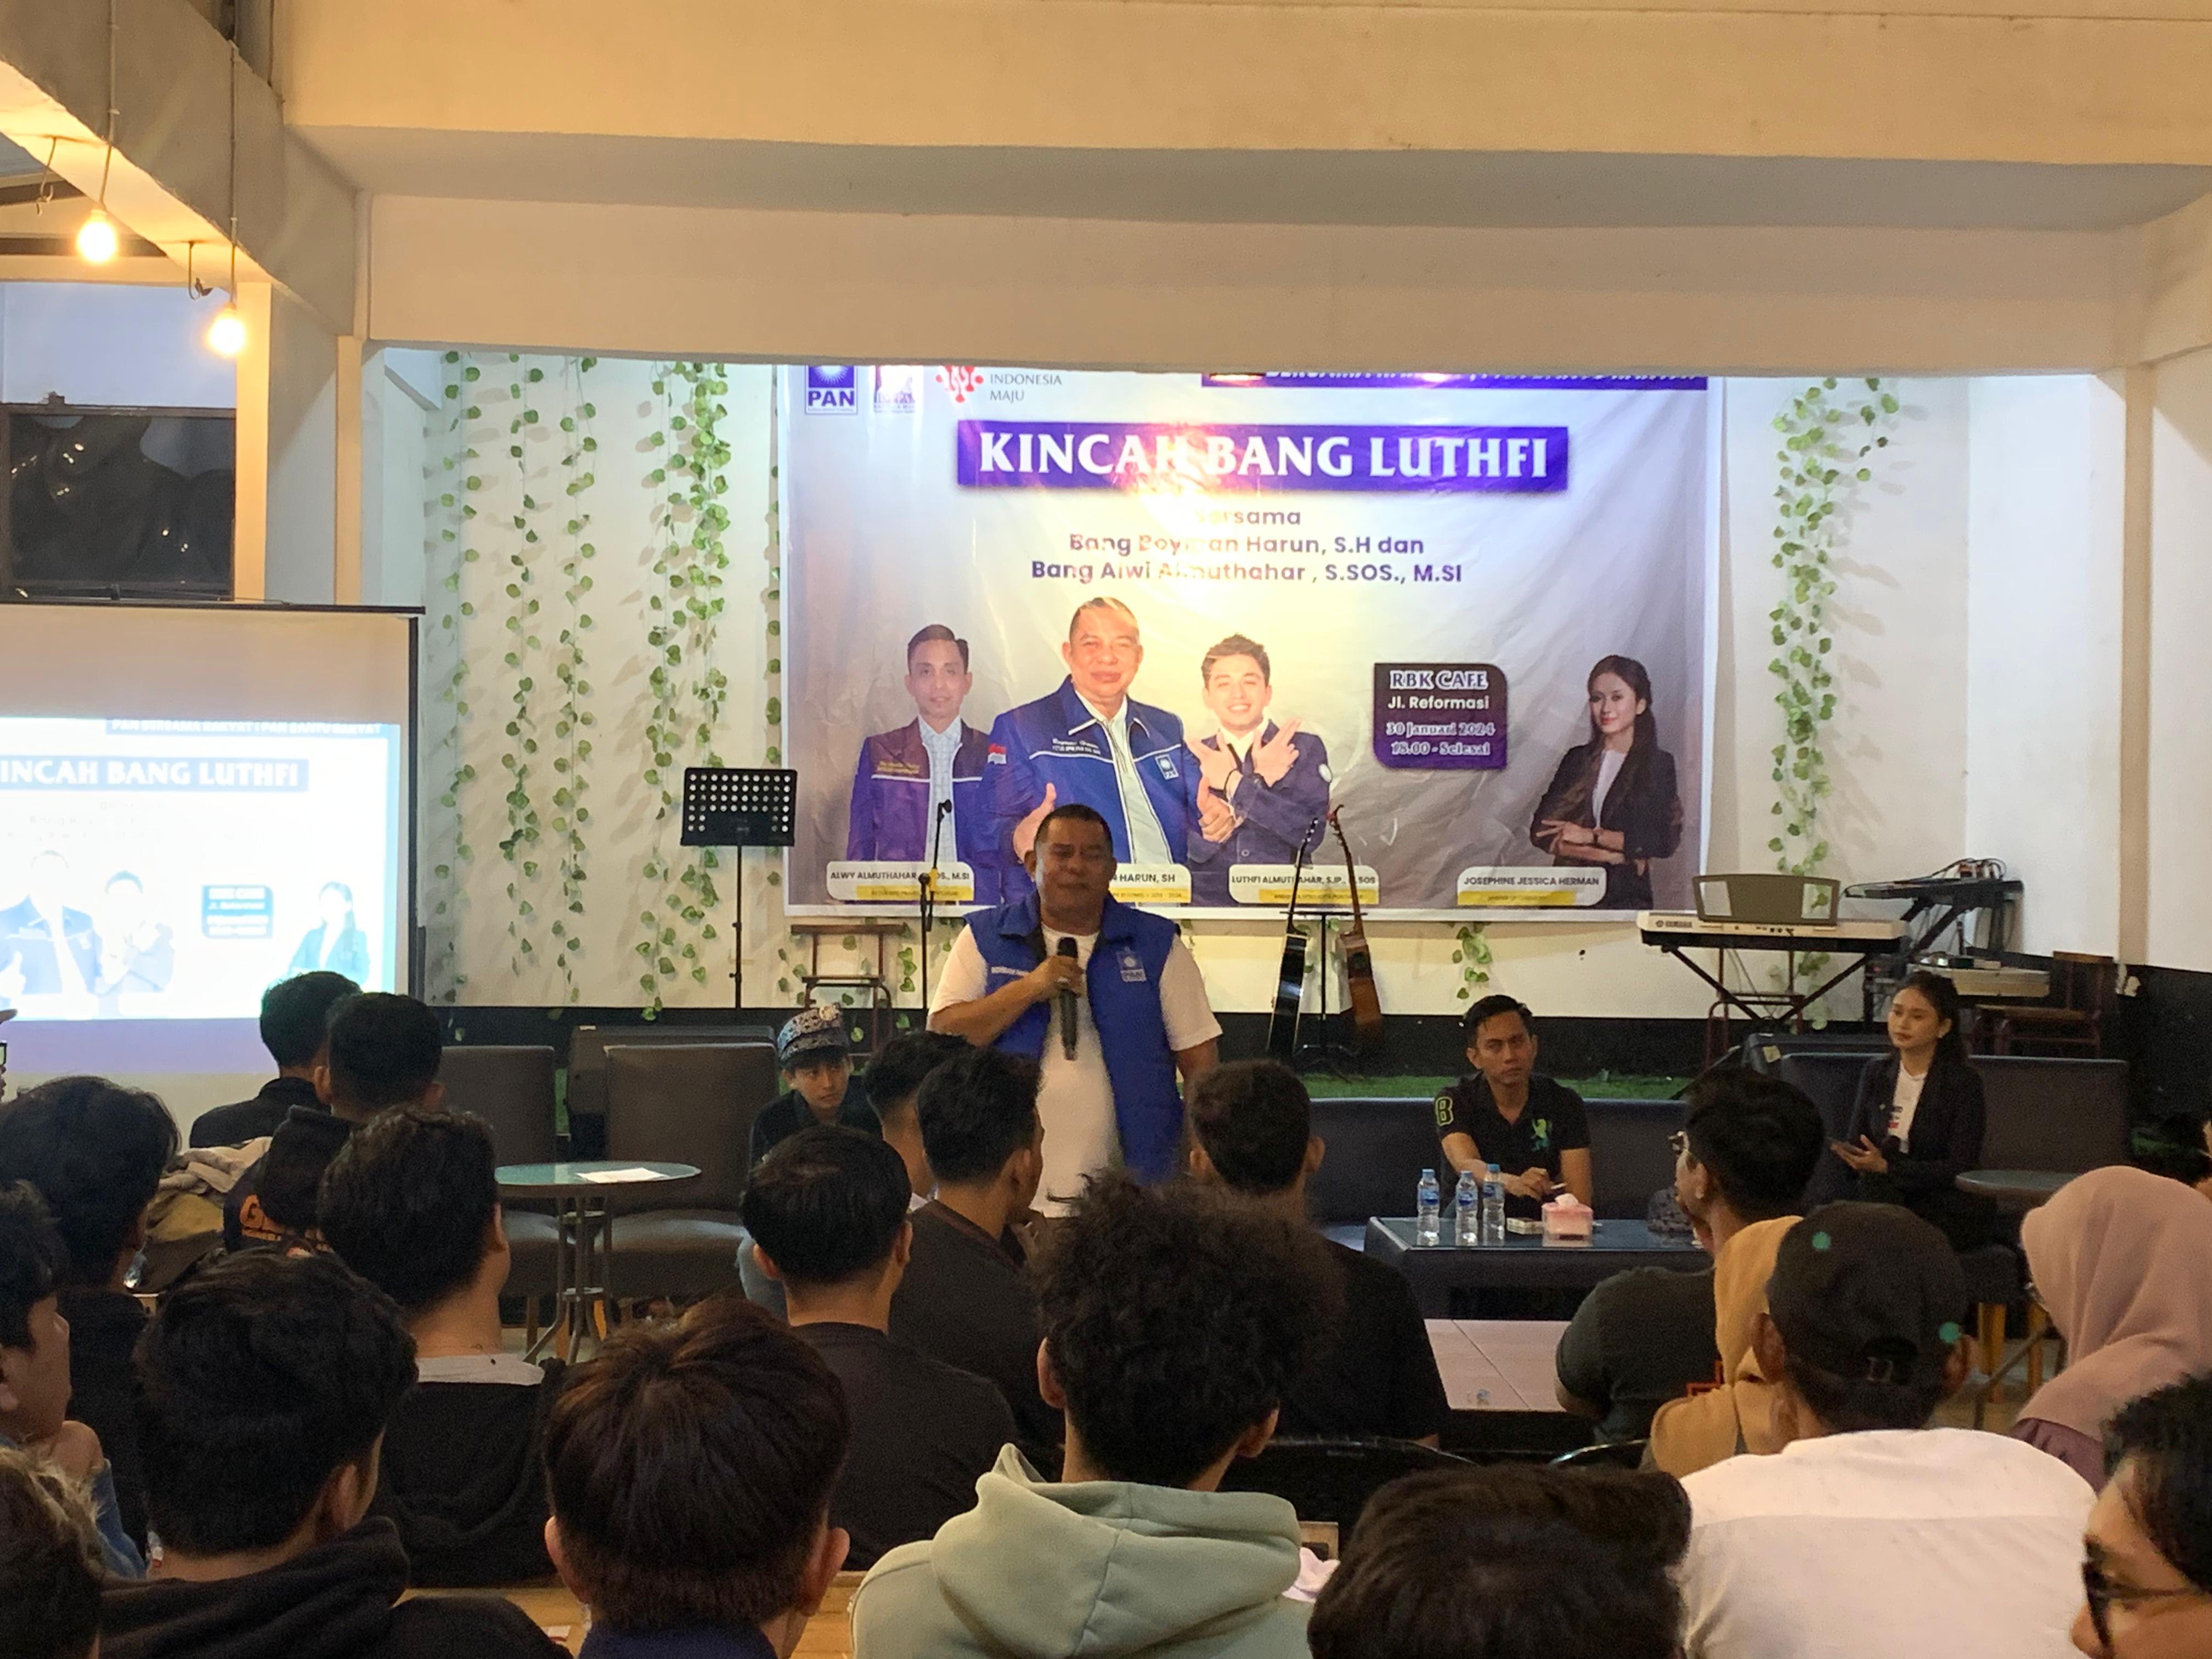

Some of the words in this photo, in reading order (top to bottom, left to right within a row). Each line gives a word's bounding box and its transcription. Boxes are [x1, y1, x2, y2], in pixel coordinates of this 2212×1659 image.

[991, 374, 1062, 386] INDONESIA
[808, 391, 855, 407] PAN
[990, 390, 1024, 402] MAJU
[980, 432, 1190, 474] KINCAH
[1206, 435, 1353, 477] BANG
[1370, 438, 1548, 478] LUTHFI
[1070, 534, 1131, 556] Bang
[1247, 537, 1327, 555] Harun,
[1334, 537, 1370, 554] S.H
[1378, 537, 1425, 554] dan
[1032, 561, 1093, 584] Bang
[1325, 565, 1406, 583] S.SOS.,
[1414, 565, 1462, 583] M.SI
[1390, 670, 1434, 689] RBK
[1435, 670, 1488, 690] CAFE
[1388, 696, 1406, 709] Jl.
[1409, 696, 1489, 709] Reformasi
[1406, 723, 1457, 738] Januari
[0, 760, 99, 785] INCAH
[106, 761, 190, 786] BANG
[198, 763, 299, 787] LUTHFI
[1120, 873, 1159, 883] HARUN,
[1161, 873, 1175, 882] SH
[1464, 877, 1515, 885] JOSEPHINE
[1517, 877, 1556, 885] JESSICA
[1435, 1097, 1453, 1126] B
